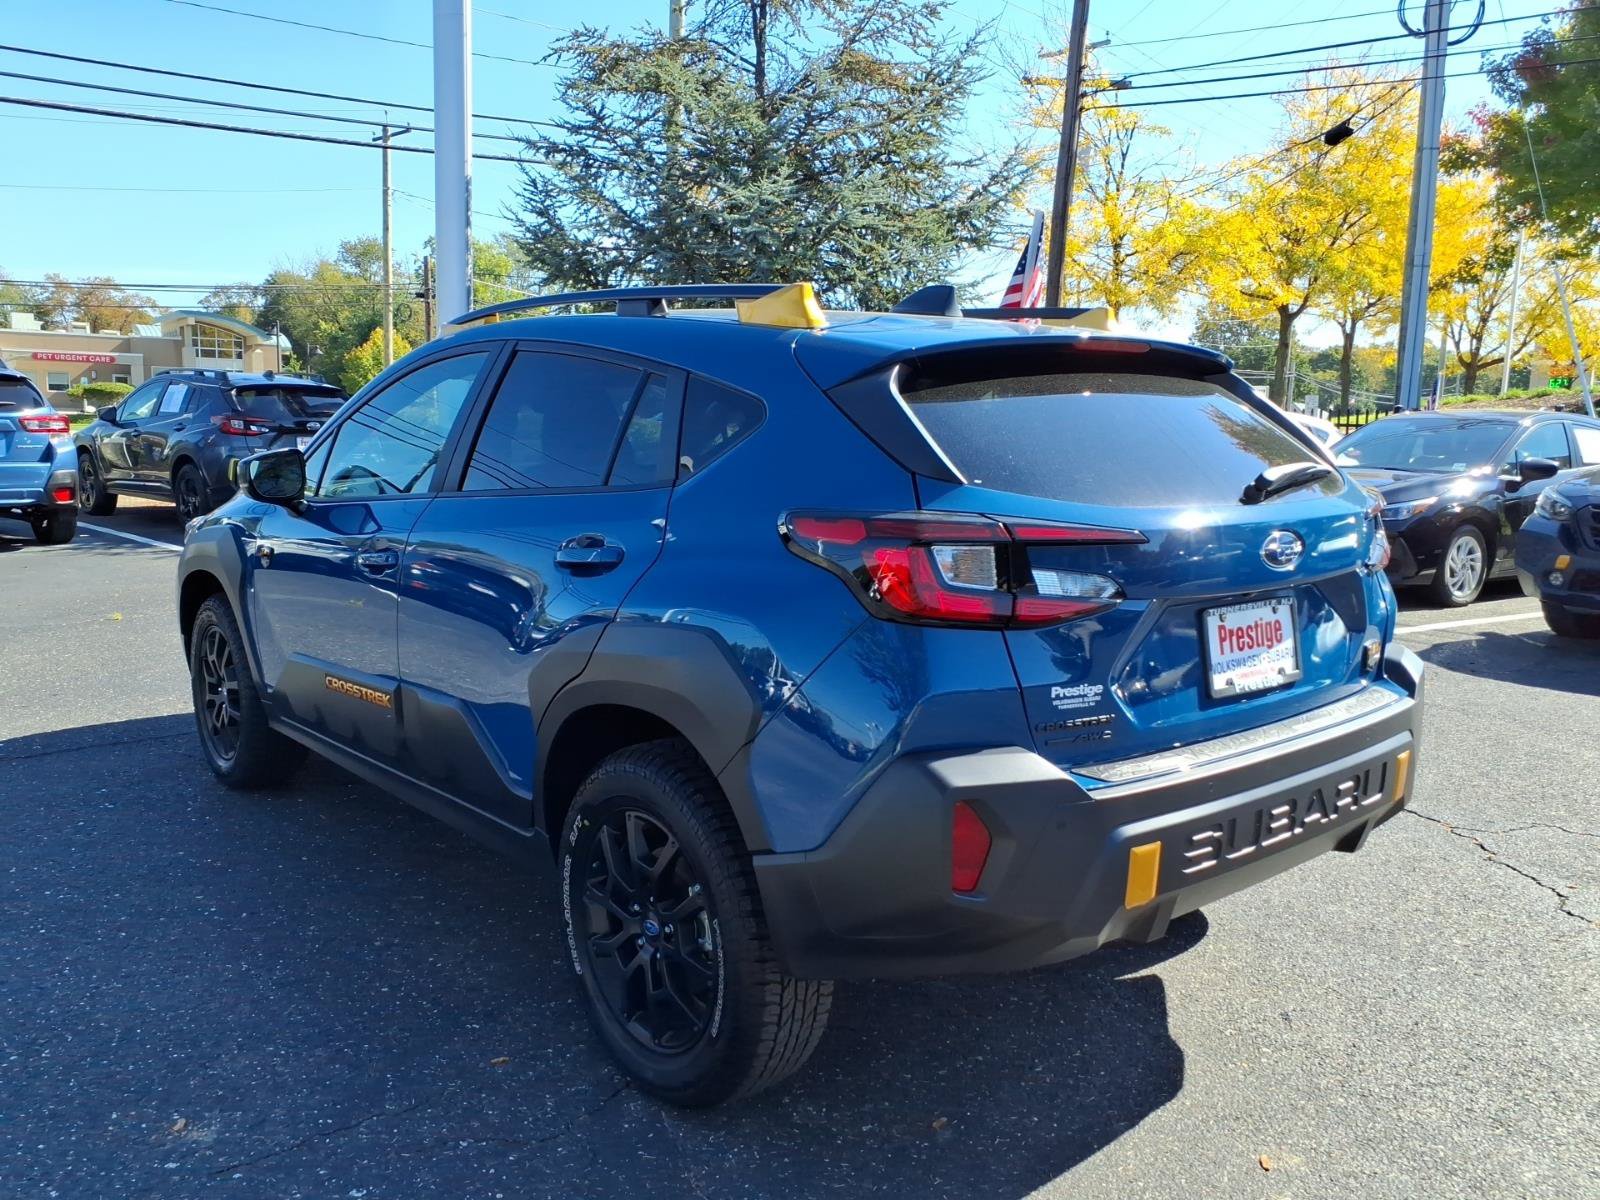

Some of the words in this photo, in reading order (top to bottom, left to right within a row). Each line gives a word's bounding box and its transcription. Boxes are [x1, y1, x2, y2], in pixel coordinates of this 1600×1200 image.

[88, 355, 111, 363] CARE
[1281, 597, 1295, 606] NJ
[1217, 617, 1283, 656] Prestige
[324, 676, 392, 709] CROSSTREK
[1050, 683, 1104, 698] Prestige
[1233, 675, 1285, 693] Prestige
[1034, 714, 1116, 732] CROSSTREK
[1182, 761, 1388, 874] SUBARU
